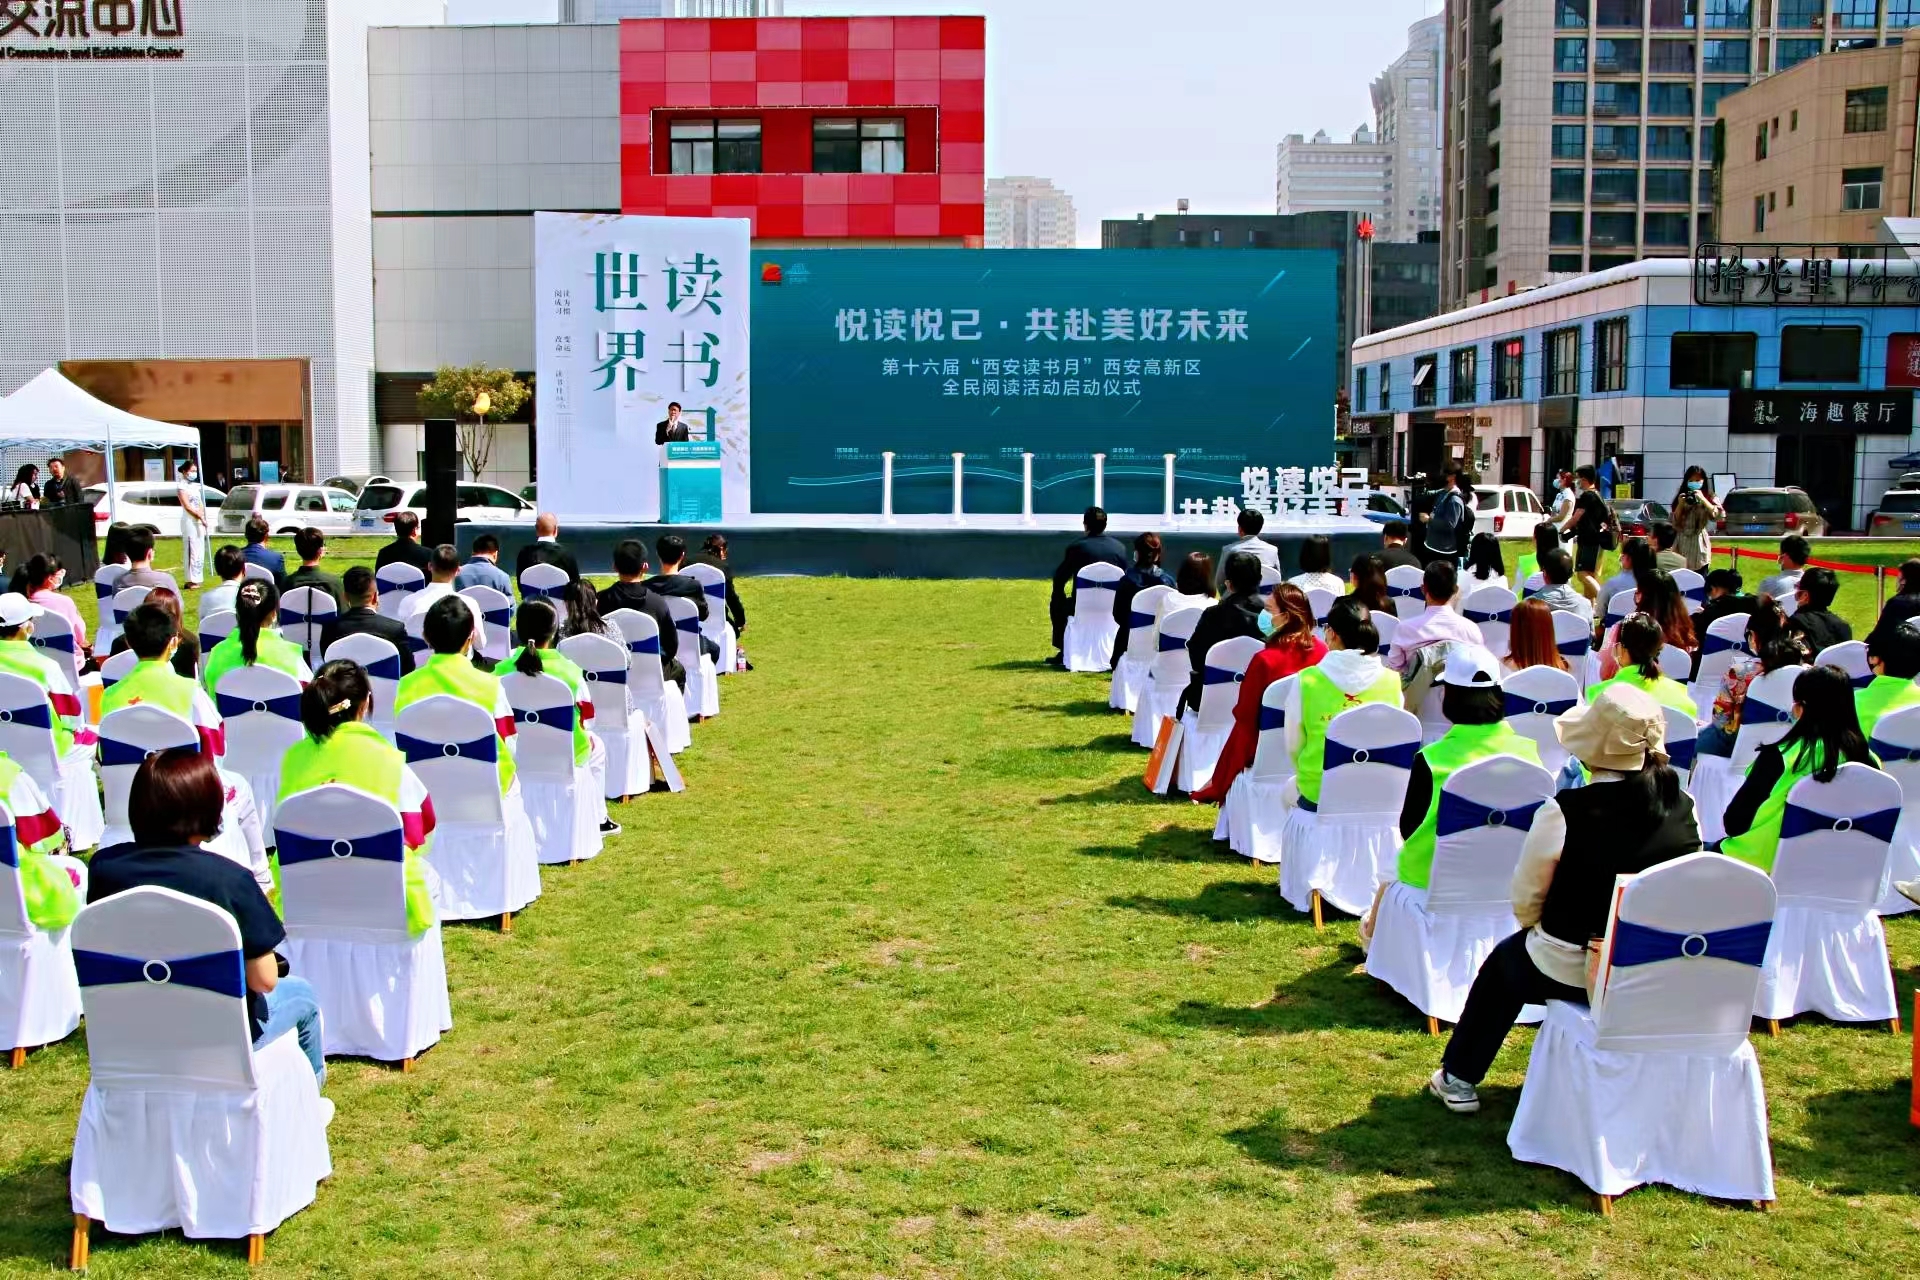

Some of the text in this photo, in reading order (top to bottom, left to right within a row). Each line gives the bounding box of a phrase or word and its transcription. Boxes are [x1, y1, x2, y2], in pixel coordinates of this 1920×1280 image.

[70, 47, 91, 58] and
[147, 47, 184, 58] Center
[1710, 255, 1836, 297] 拾光里
[942, 378, 1142, 397] 全民阅读活动启动仪式
[1799, 401, 1897, 423] 海趣餐厅
[1241, 466, 1370, 500] 悦读悦己
